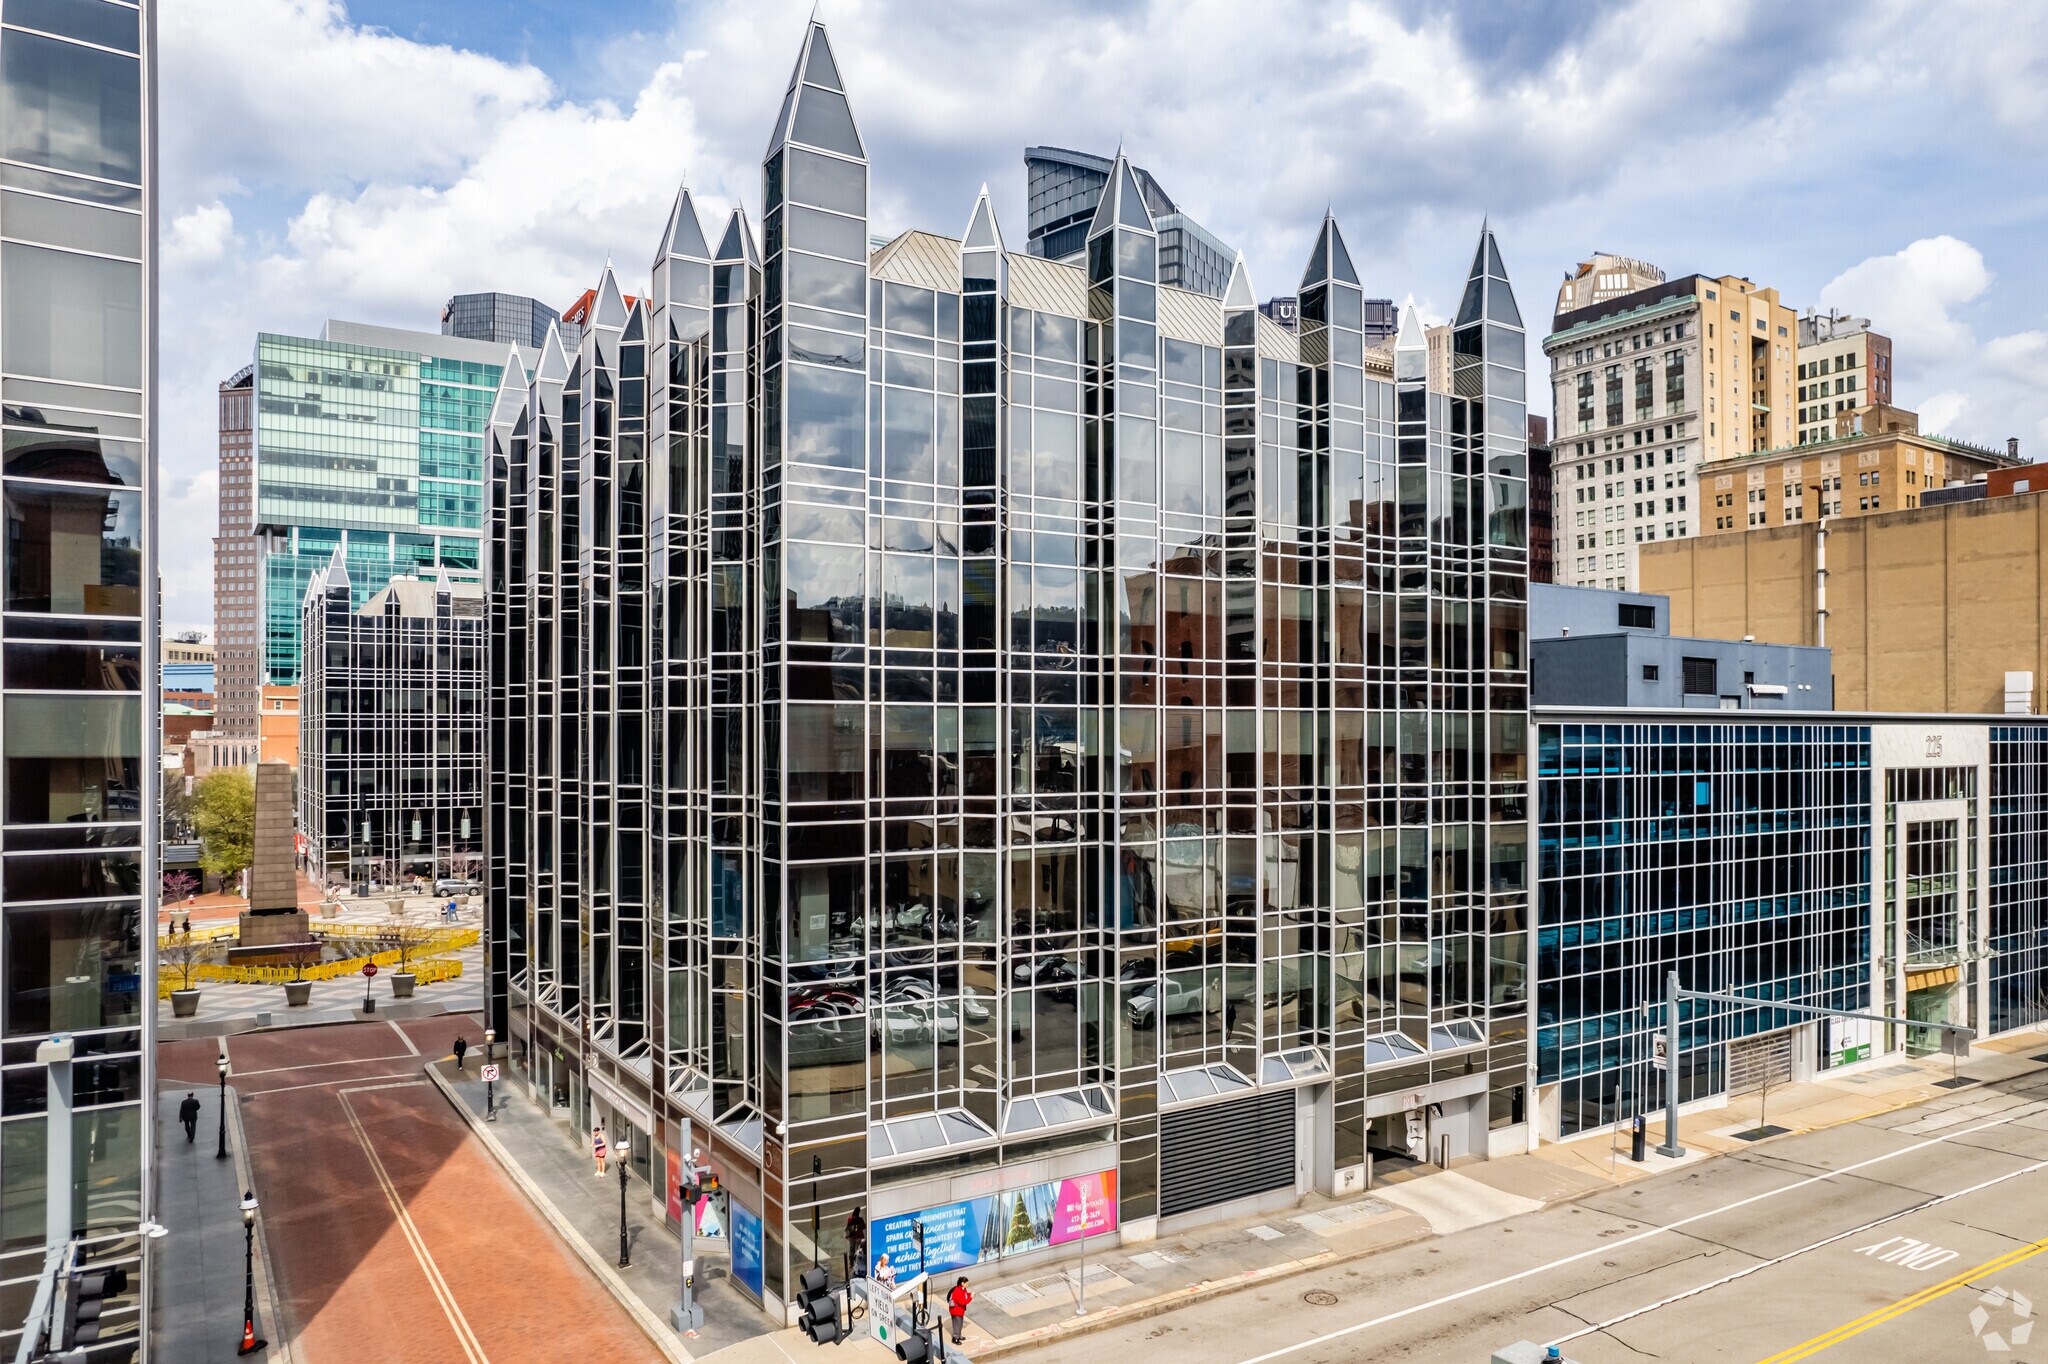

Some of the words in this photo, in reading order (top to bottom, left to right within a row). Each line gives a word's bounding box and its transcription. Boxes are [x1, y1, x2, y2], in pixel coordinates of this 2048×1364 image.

[1637, 260, 1666, 283] MELLO
[1926, 735, 1942, 758] 225
[331, 840, 338, 849] 3
[765, 1140, 772, 1168] 5
[885, 1219, 911, 1231] CREATING
[913, 1210, 952, 1224] NVIRONMENTS
[953, 1207, 966, 1217] THAT
[885, 1232, 903, 1243] SPARK
[946, 1218, 966, 1229] WHERE
[887, 1245, 897, 1254] THE
[898, 1242, 911, 1252] BEST
[924, 1232, 953, 1245] BRIGHTEST
[953, 1230, 965, 1239] CAN
[1853, 1235, 1960, 1271] ONLY
[908, 1262, 921, 1272] THEY
[944, 1252, 960, 1264] APART
[870, 1283, 880, 1295] LEFT
[881, 1289, 892, 1304] TURN
[871, 1308, 878, 1318] ON
[879, 1312, 893, 1329] GREEN
[875, 1299, 889, 1315] YIELD
